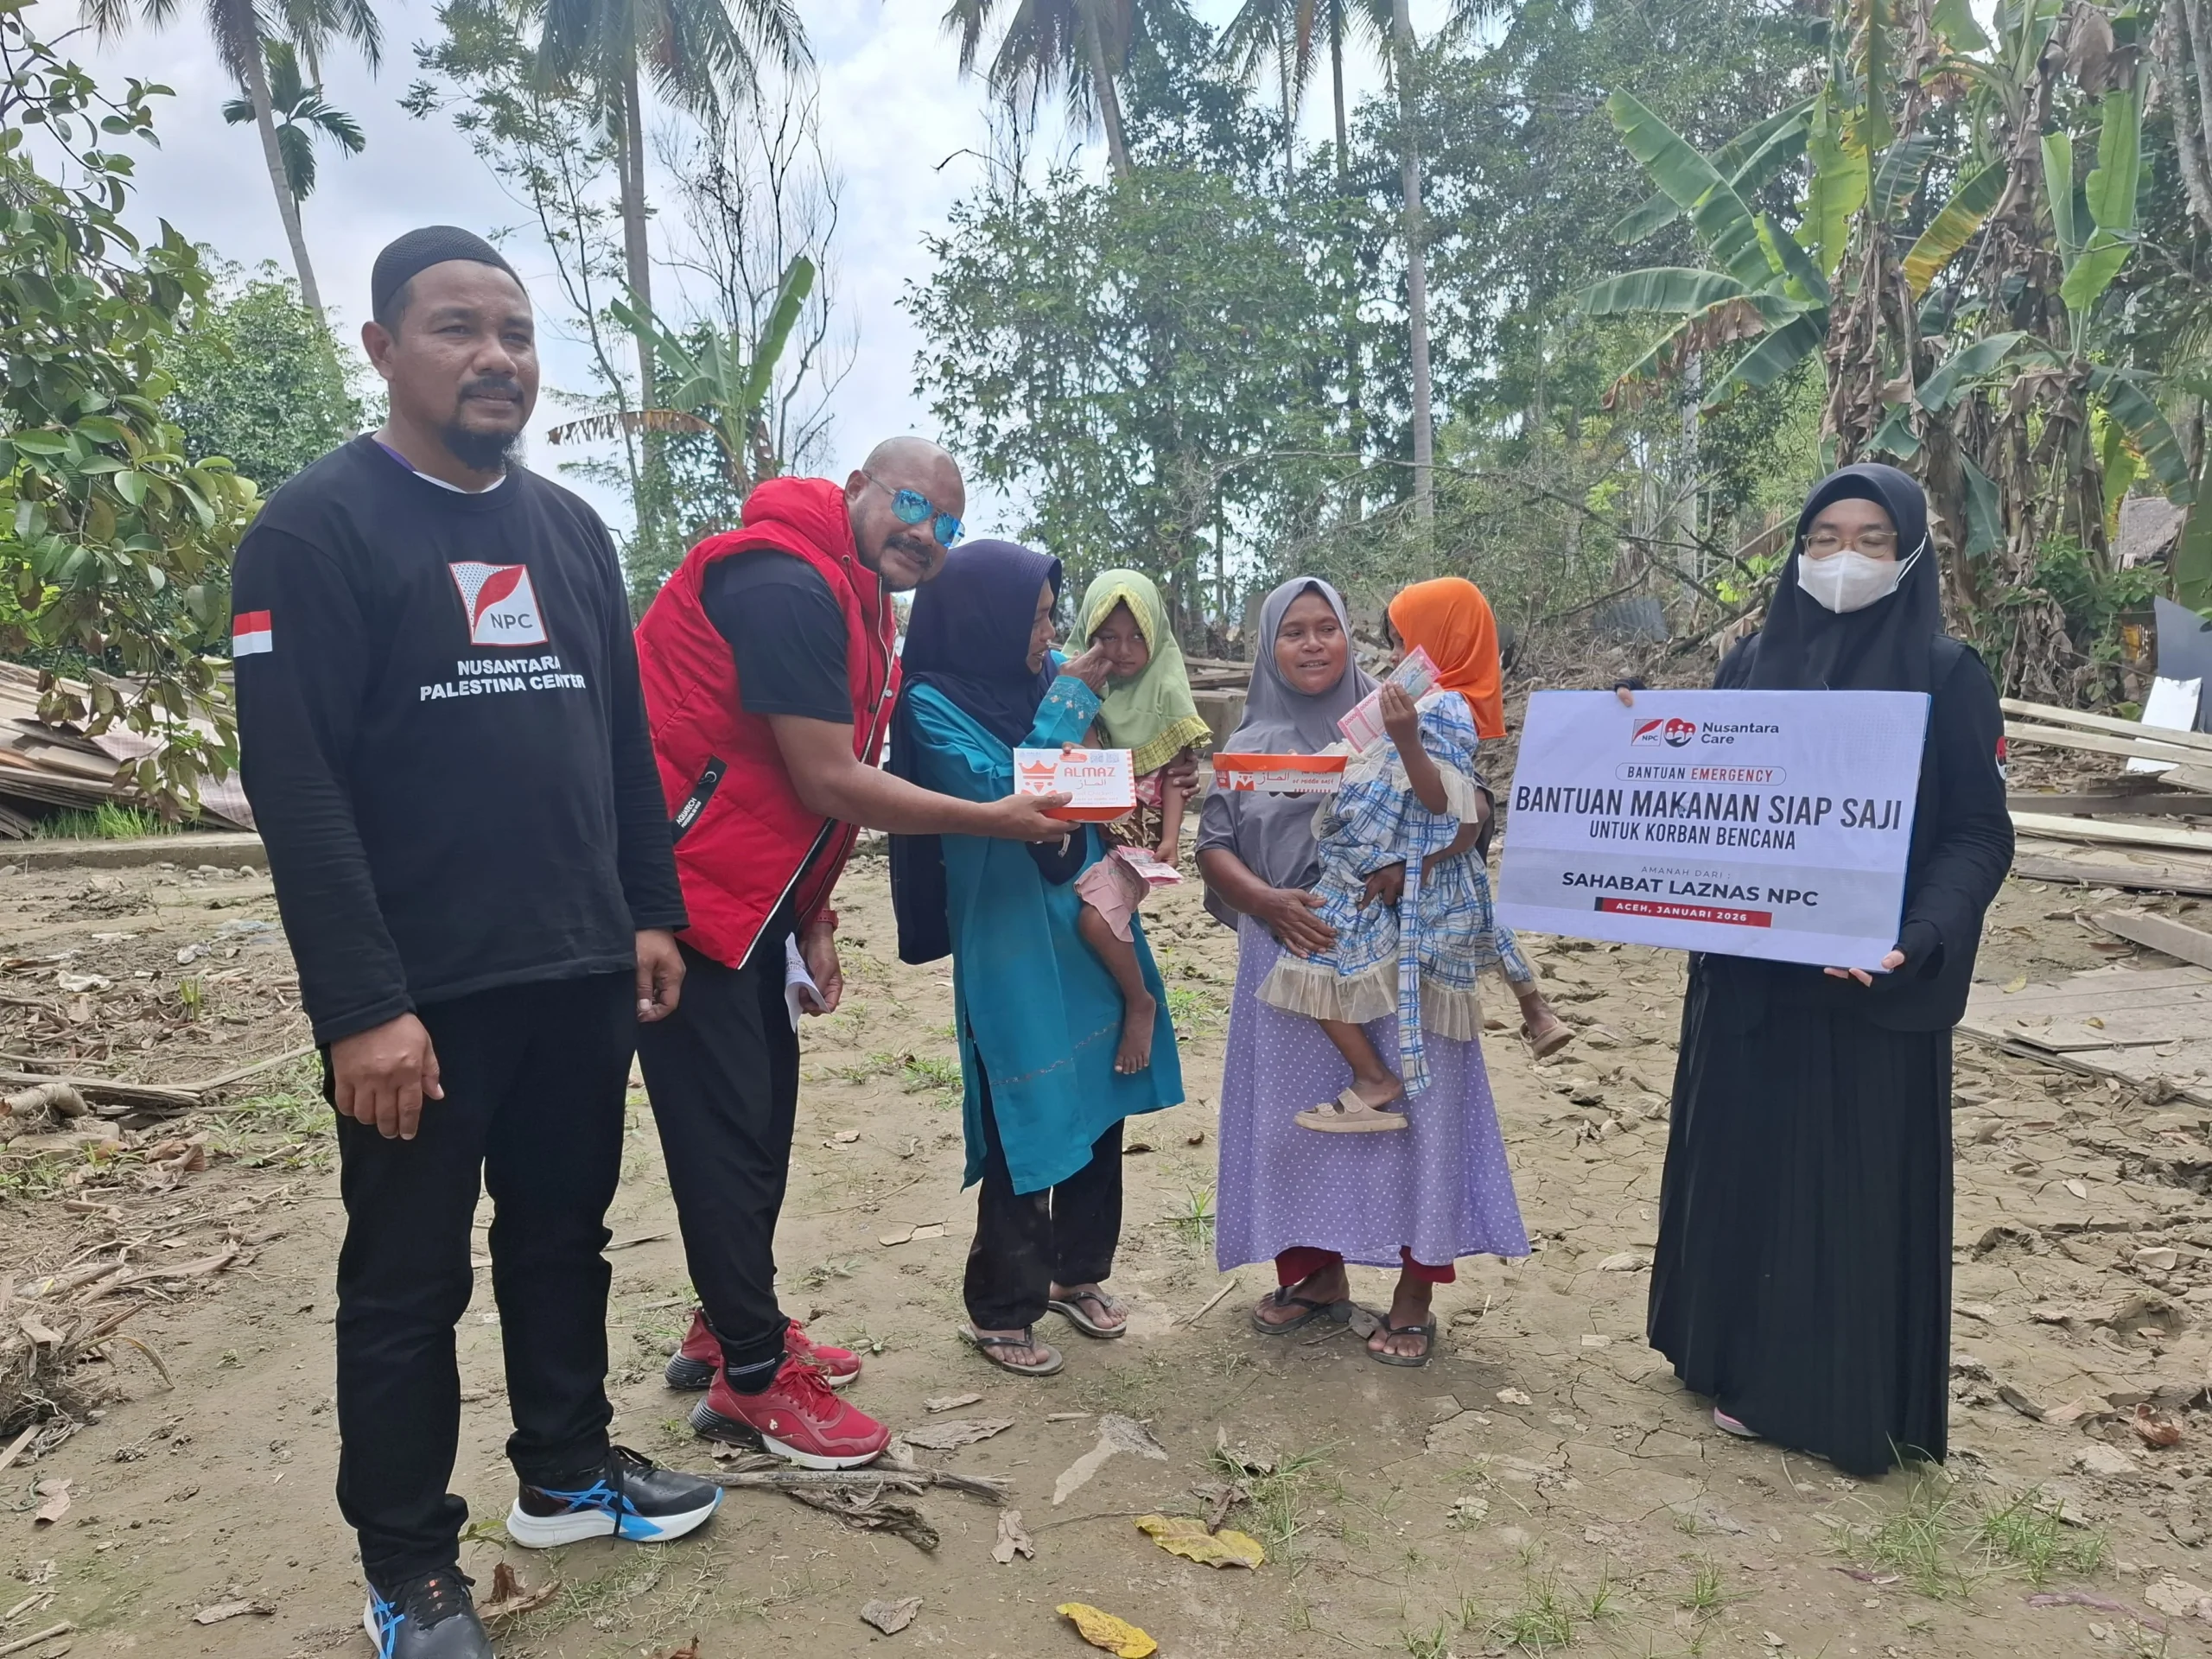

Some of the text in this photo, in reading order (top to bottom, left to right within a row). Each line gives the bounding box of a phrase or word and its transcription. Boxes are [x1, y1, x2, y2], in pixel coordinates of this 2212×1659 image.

[490, 613, 533, 630] NPC
[457, 655, 562, 676] NUSANTARA
[420, 673, 587, 702] PALESTINA CENTER
[1701, 721, 1780, 734] Nusantara
[1700, 734, 1735, 745] Care
[1064, 766, 1116, 778] ALMAZ
[1627, 766, 1774, 783] BANTUAN EMERGENCY
[676, 797, 697, 825] AQUATECH
[1516, 785, 1903, 830] BANTUAN MAKANAN SIAP SAJI
[1589, 819, 1796, 850] UNTUK KORBAN BENCANA
[1641, 866, 1690, 876] AMANAH
[1694, 869, 1723, 879] DARI
[1561, 871, 1819, 907] SAHABAT LAZNAS NPC
[1616, 902, 1747, 922] ACEH, JANUARI 2026
